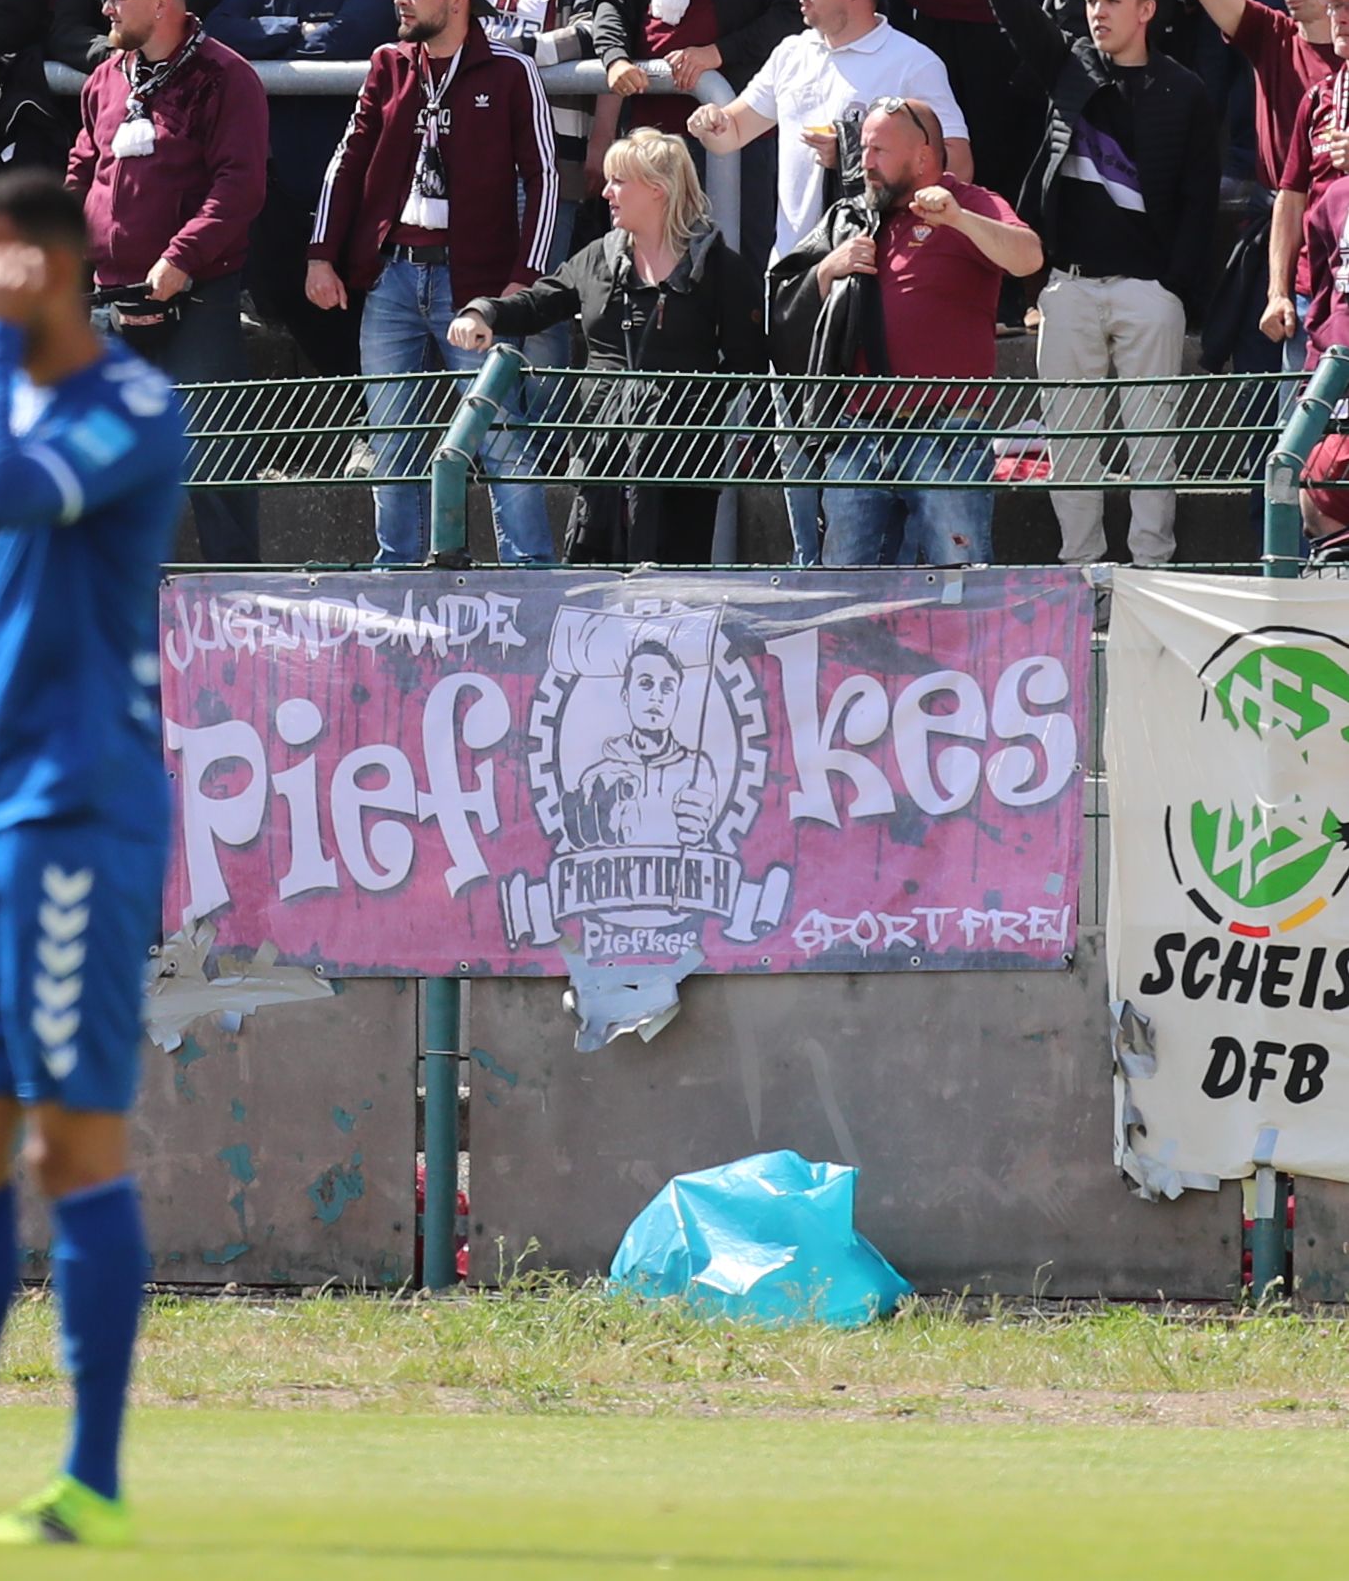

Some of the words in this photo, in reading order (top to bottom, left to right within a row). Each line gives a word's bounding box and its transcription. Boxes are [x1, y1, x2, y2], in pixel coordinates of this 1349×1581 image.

[557, 855, 731, 916] FRAKTION-H
[791, 908, 958, 955] SPORT
[1201, 1036, 1331, 1105] DFB
